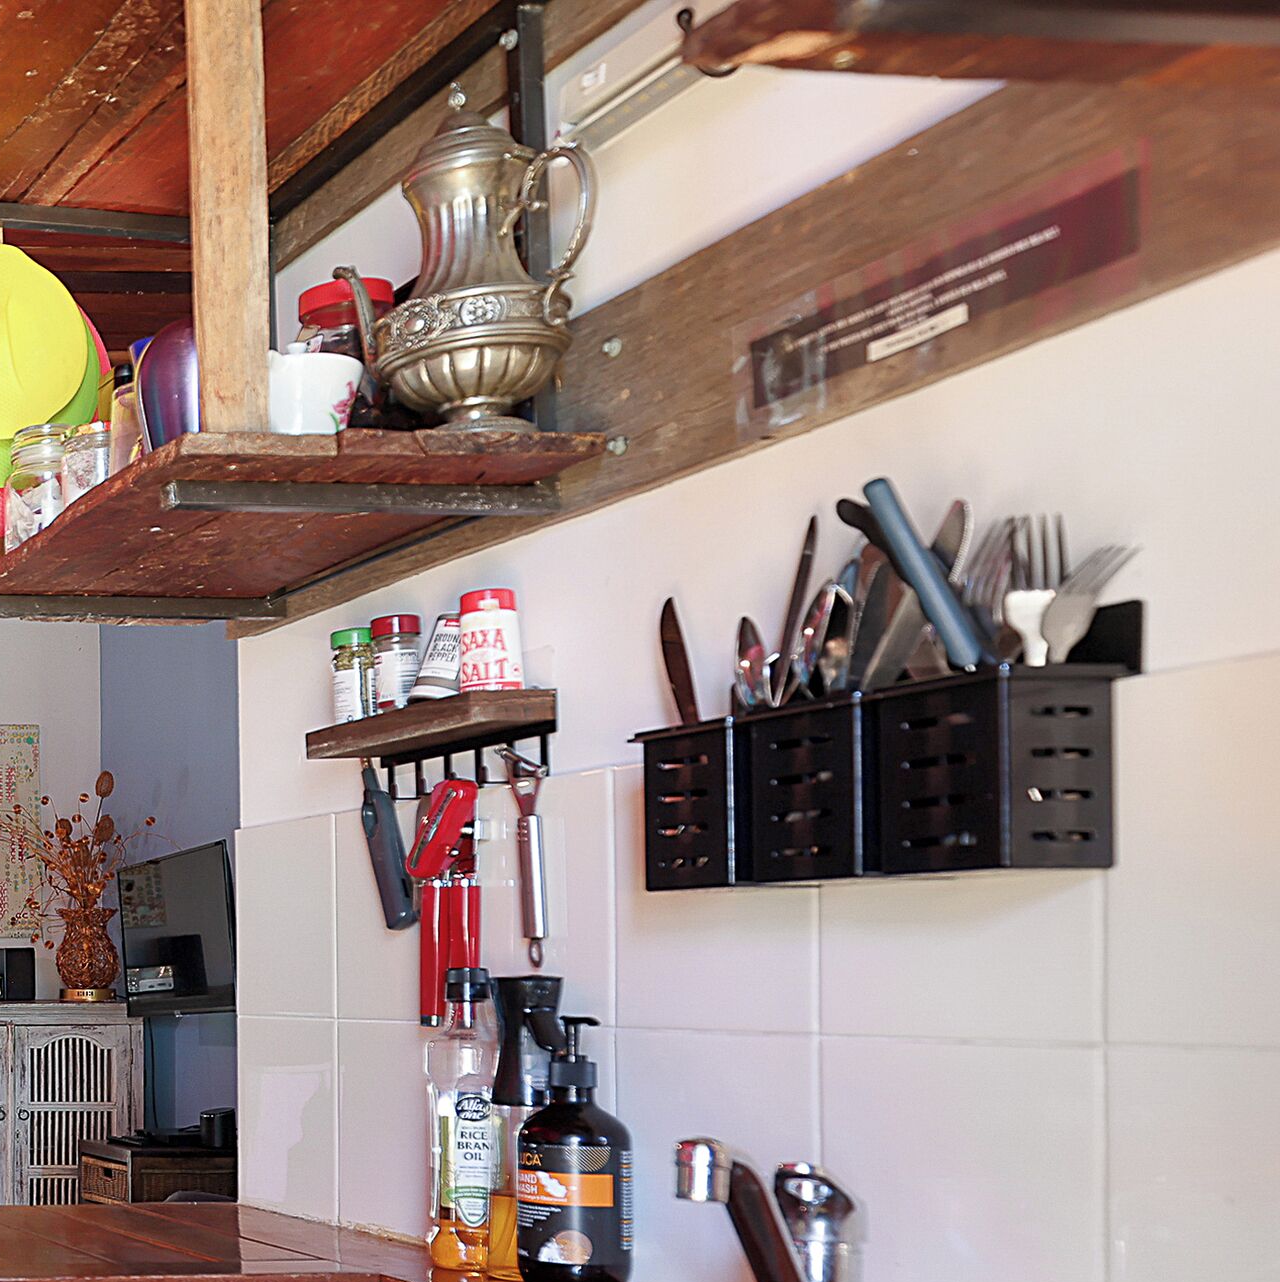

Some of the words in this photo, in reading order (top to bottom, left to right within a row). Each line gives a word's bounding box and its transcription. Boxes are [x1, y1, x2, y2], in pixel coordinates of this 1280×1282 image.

[461, 628, 507, 656] SAXA
[431, 643, 459, 653] BLACK
[427, 651, 457, 663] PEPPER
[461, 657, 509, 685] SALT
[458, 1098, 483, 1112] Alfa
[461, 1109, 483, 1120] one
[460, 1130, 488, 1140] RICE
[457, 1141, 491, 1151] BRAN
[463, 1151, 485, 1161] OIL
